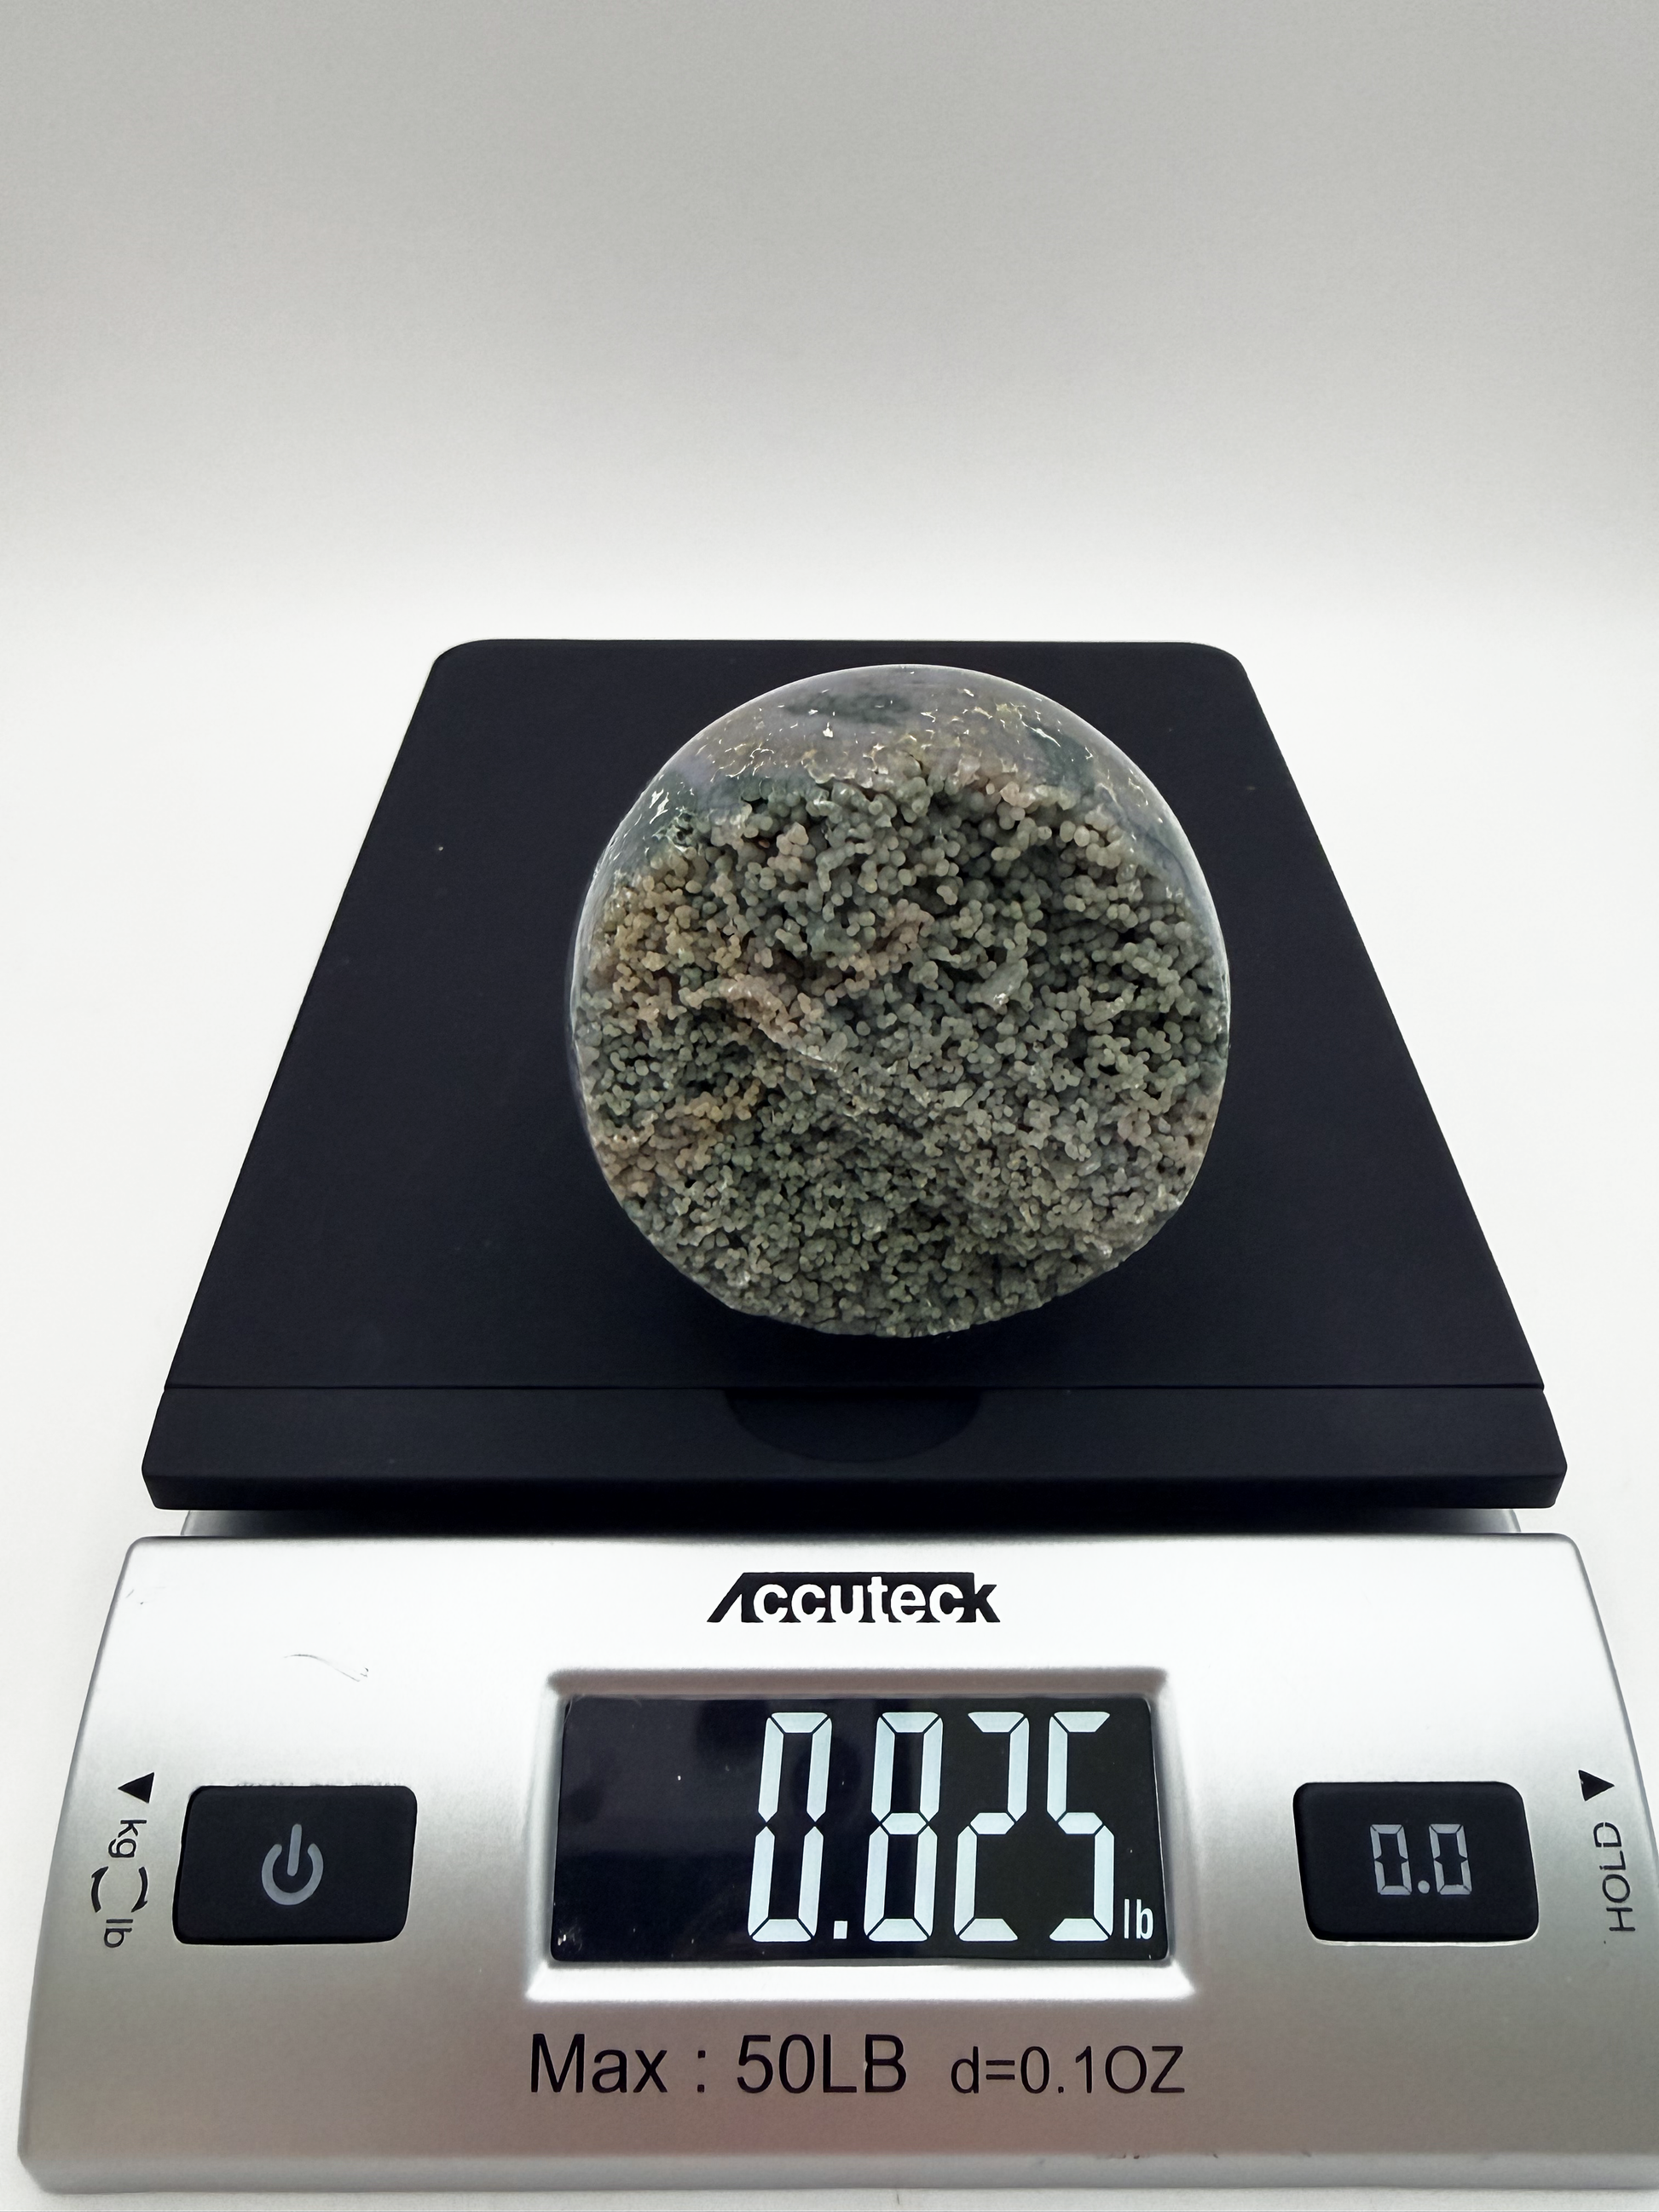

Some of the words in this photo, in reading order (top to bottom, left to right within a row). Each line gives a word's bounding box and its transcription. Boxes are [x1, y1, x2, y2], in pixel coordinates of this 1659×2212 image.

[707, 1573, 1001, 1623] Accuteck
[108, 1819, 147, 1858] kg
[748, 1712, 1114, 1942] 0.825
[1123, 1899, 1154, 1940] lb
[1369, 1823, 1472, 1896] 0.0
[1593, 1822, 1635, 1932] HOLD
[104, 1919, 134, 1948] lb
[530, 2033, 669, 2094] Max
[736, 2034, 907, 2094] 50LB
[951, 2046, 1187, 2096] d=0.1OZ
